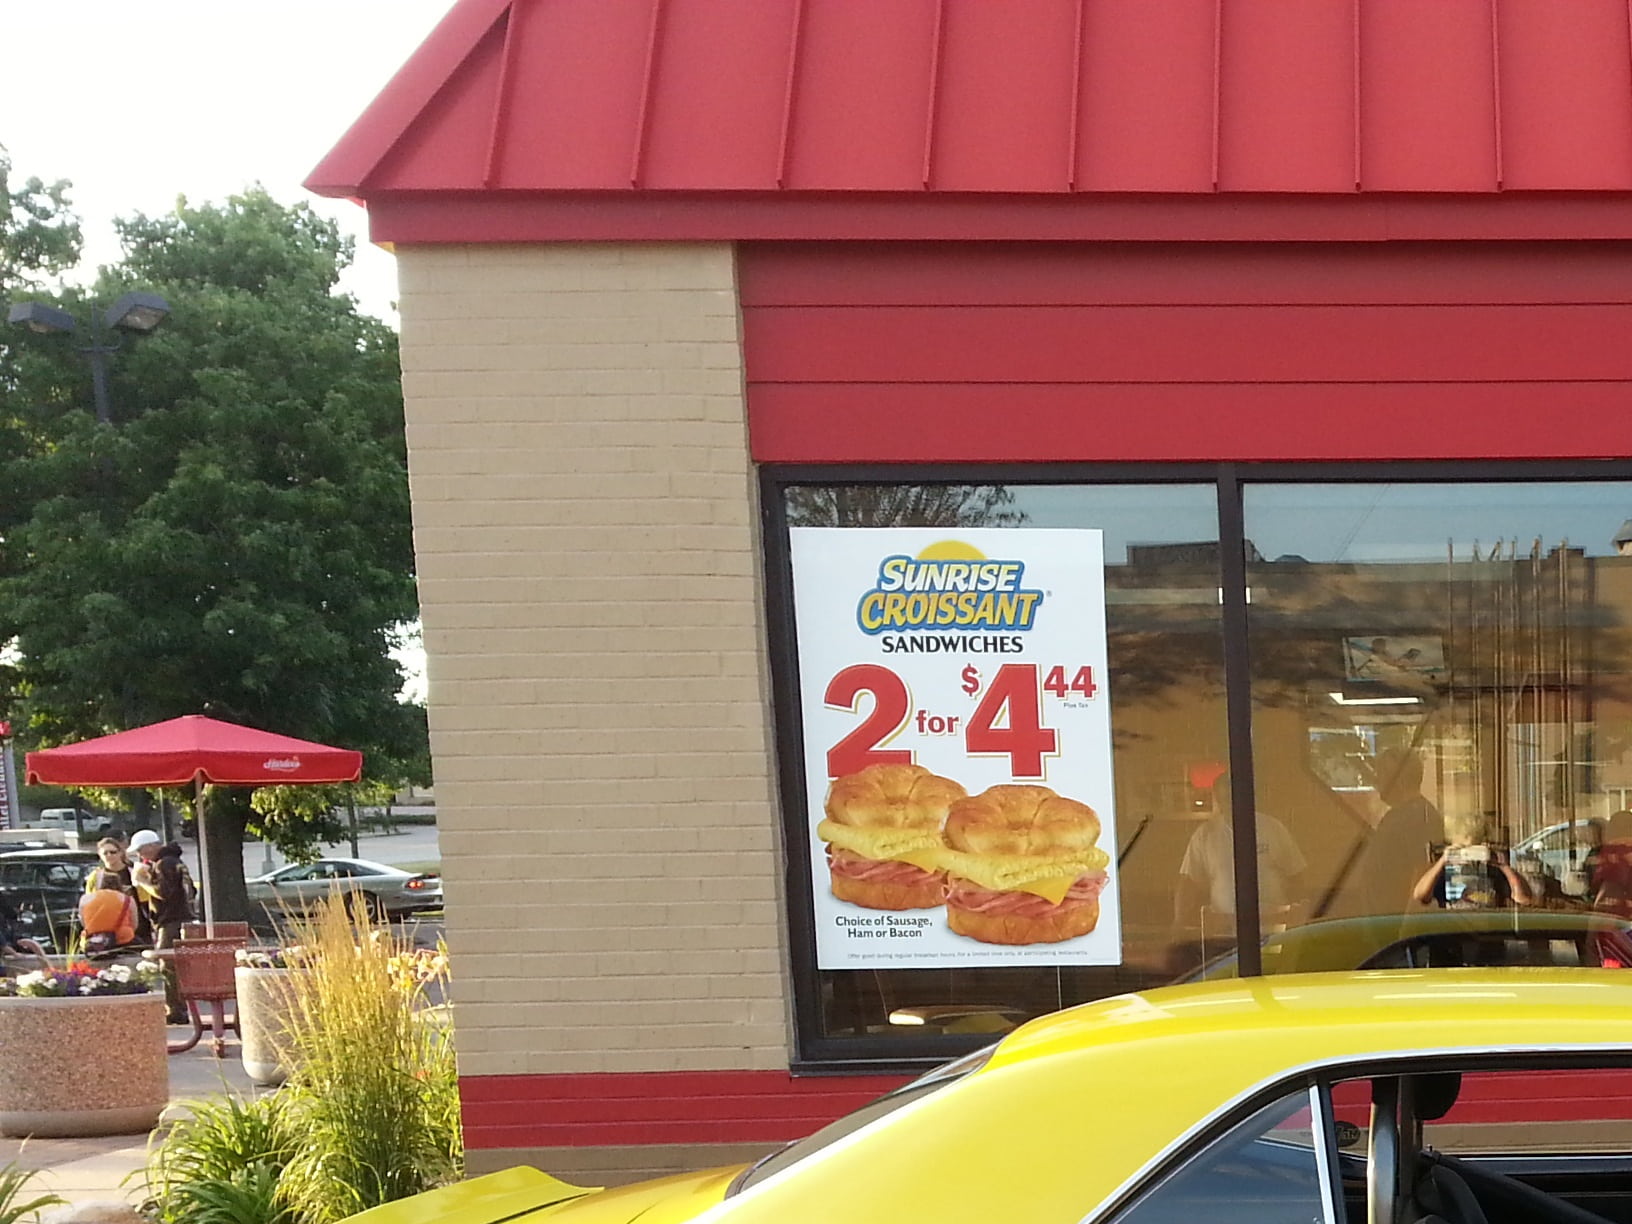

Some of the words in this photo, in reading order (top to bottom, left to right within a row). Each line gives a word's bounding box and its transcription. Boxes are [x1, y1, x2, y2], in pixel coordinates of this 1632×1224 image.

[880, 560, 1019, 592] SUNRISE
[861, 591, 1039, 629] CROISSANT
[882, 635, 1024, 654] SANDWICHES
[824, 663, 913, 779] 2
[915, 709, 959, 735] for
[835, 915, 873, 927] Choice
[874, 915, 885, 926] of
[886, 916, 933, 928] Sausage,
[847, 929, 874, 938] Ham
[875, 930, 888, 938] or
[889, 928, 923, 938] Bacon
